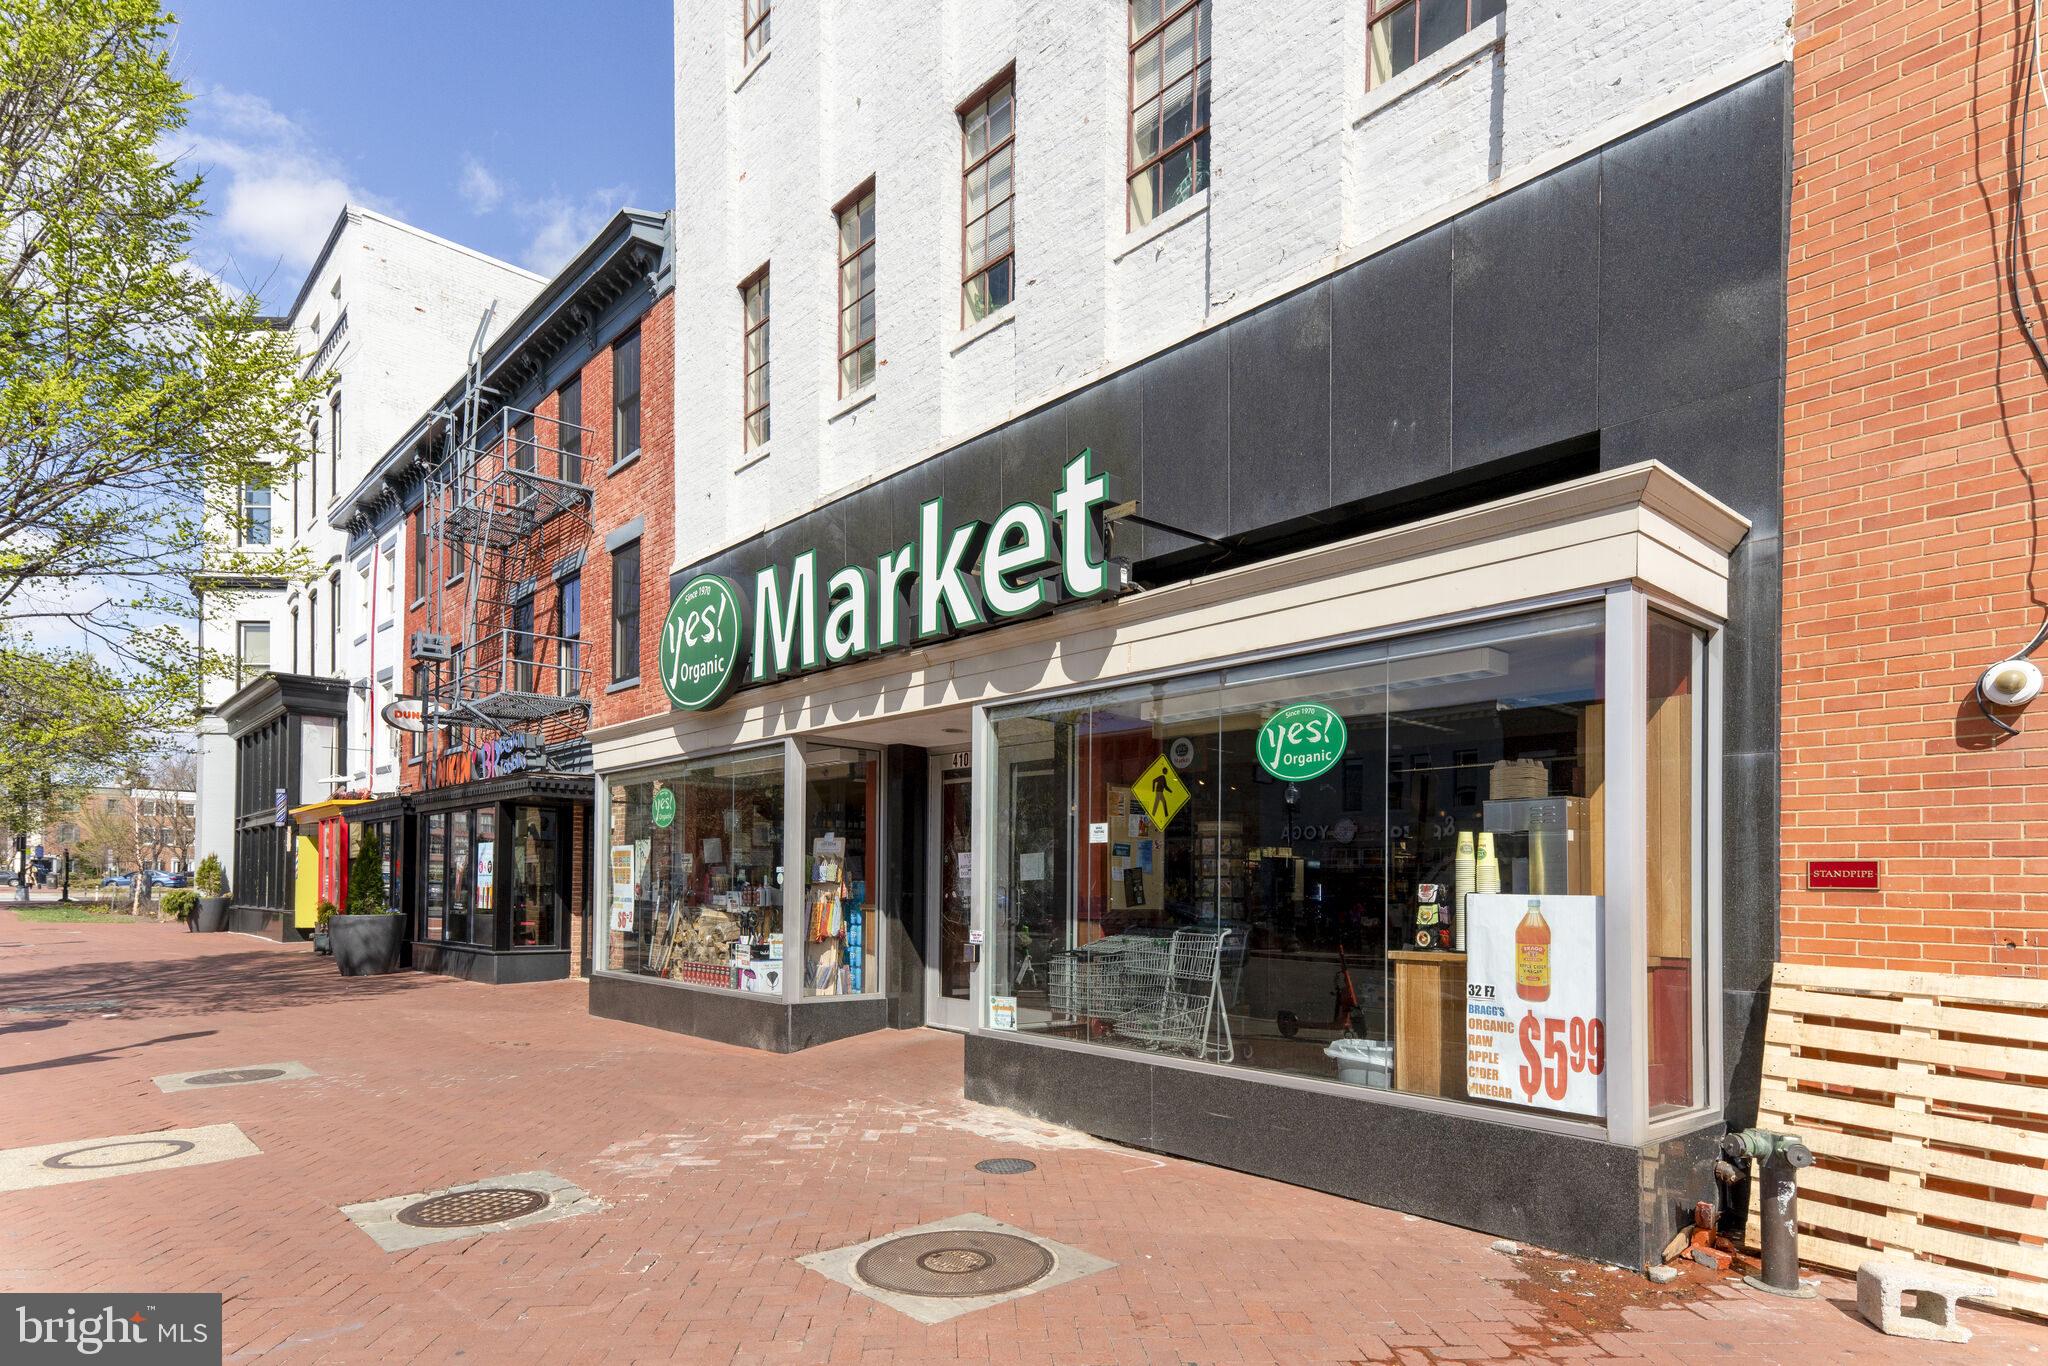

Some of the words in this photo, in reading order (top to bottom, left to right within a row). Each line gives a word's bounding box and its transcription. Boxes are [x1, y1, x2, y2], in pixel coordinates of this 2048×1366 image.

[752, 447, 1110, 682] Market
[684, 590, 698, 605] Since
[698, 585, 711, 598] 1970
[668, 592, 727, 690] yes!
[680, 654, 725, 684] Organic
[1285, 709, 1300, 719] Since
[1301, 707, 1316, 715] 1970
[1266, 713, 1333, 770] yes!
[952, 752, 969, 768] 410
[1283, 749, 1332, 767] Organic
[654, 794, 673, 822] yes!
[1813, 870, 1874, 878] STANDPIPE
[1468, 984, 1482, 997] 32
[1484, 985, 1496, 998] FZ
[1468, 1004, 1505, 1017] BRAGG'S
[1468, 1018, 1515, 1034] ORGANIC
[1468, 1034, 1494, 1047] RAW
[1468, 1050, 1499, 1065] APPLE
